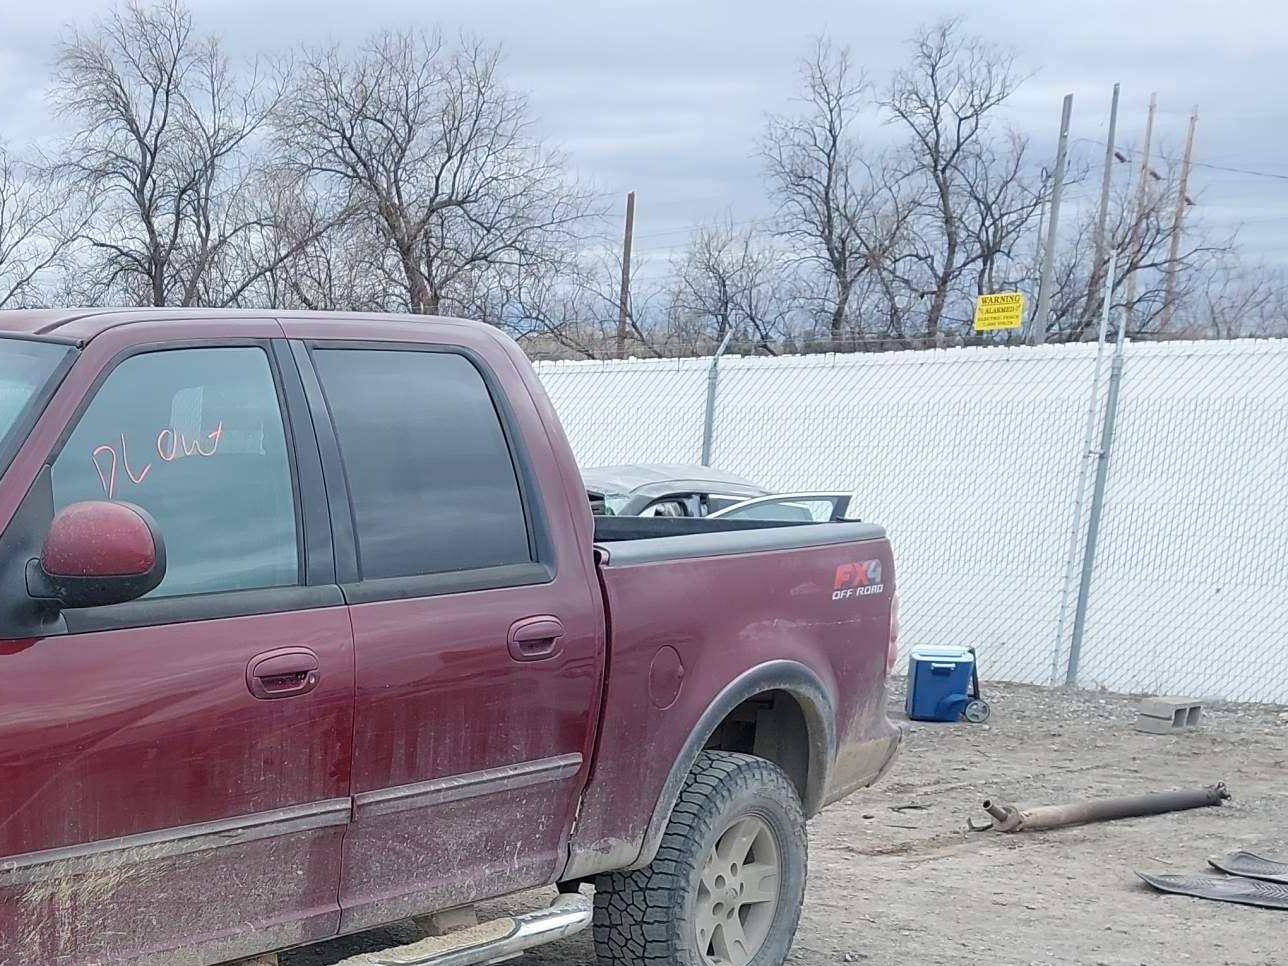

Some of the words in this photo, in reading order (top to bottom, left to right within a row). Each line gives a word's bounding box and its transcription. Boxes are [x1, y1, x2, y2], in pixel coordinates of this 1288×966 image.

[982, 295, 1020, 304] WARNING
[985, 306, 1014, 314] ALARMED
[834, 559, 882, 589] FX4
[832, 589, 854, 600] OFF
[856, 584, 883, 597] ROAD
